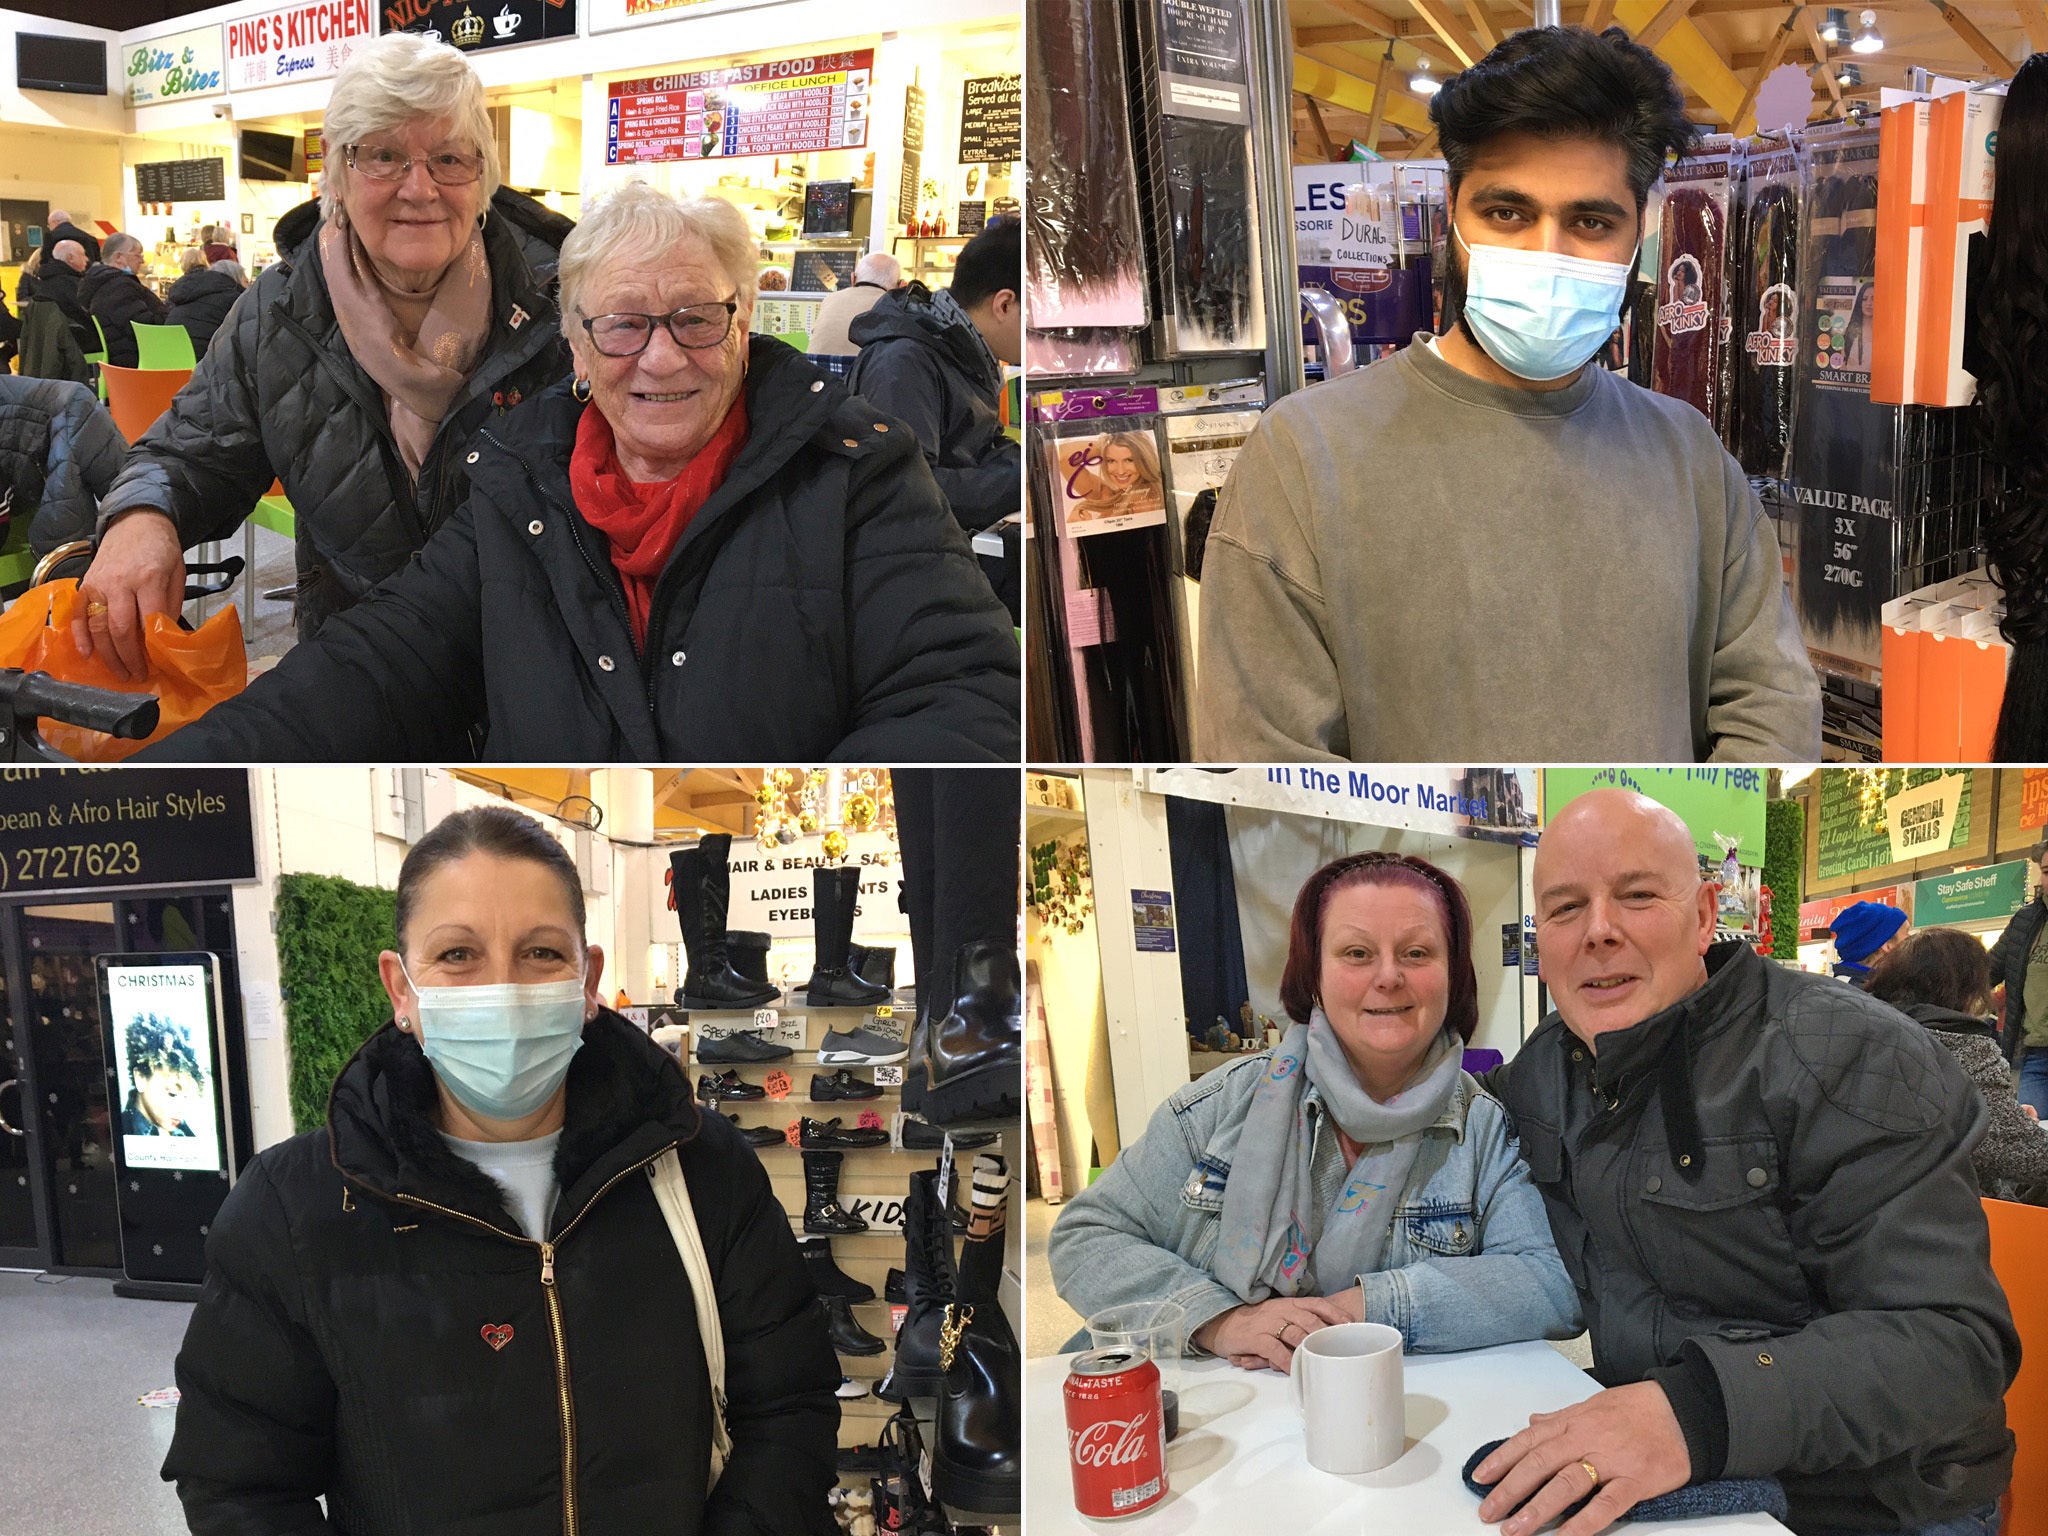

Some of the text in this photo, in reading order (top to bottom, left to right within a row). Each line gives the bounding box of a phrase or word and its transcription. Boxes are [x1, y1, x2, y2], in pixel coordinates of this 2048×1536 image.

[1162, 0, 1232, 19] DOUBLE WEFTED
[288, 0, 369, 48] KITCHEN
[127, 46, 194, 77] Bitz &
[276, 53, 315, 78] Express
[160, 67, 220, 96] Bitez
[653, 57, 815, 91] CHINESE FAST FOOD
[744, 75, 836, 93] OFFICE LUNCH
[636, 94, 667, 105] SPRING ROLL
[788, 90, 802, 98] WITH
[803, 86, 830, 97] NOODLES
[968, 93, 1009, 105] Served all
[611, 102, 617, 115] A
[642, 107, 654, 115] Eggs
[655, 105, 668, 113] Fried
[669, 104, 679, 112] Rice
[792, 99, 804, 108] WITH
[805, 96, 828, 107] NOODLES
[767, 112, 789, 121] CHICKEN
[790, 110, 803, 119] WITH
[804, 107, 828, 117] NOODLES
[965, 107, 983, 116] LARGE
[610, 124, 617, 137] B
[624, 120, 638, 129] SPRING
[653, 118, 670, 127] CHICKEN
[740, 125, 762, 134] CHICKEN
[766, 122, 787, 132] PEANUT
[787, 120, 801, 129] WITH
[802, 118, 827, 128] NOODLES
[964, 121, 987, 129] MEDIUM
[642, 129, 654, 138] Eggs
[655, 127, 667, 135] Fried
[668, 126, 679, 134] Rice
[750, 133, 784, 143] VEGETABLES
[785, 131, 799, 140] WITH
[800, 129, 826, 138] NOODLES
[649, 139, 670, 147] CHICKEN
[752, 143, 771, 152] FOOD
[772, 142, 790, 151] WITH
[792, 139, 826, 150] NOODLES
[609, 146, 616, 159] C
[963, 148, 987, 156] EXTRAS
[1664, 163, 1726, 178] SMART BRAID
[1295, 182, 1346, 211] ES
[1337, 249, 1388, 264] COLLECTIONS
[1335, 270, 1390, 283] RED
[1659, 305, 1683, 320] AFRO
[1672, 311, 1705, 331] KINKY
[1747, 334, 1770, 348] AFRO
[1759, 347, 1793, 362] KINKY
[1820, 370, 1854, 382] SMART
[1792, 486, 1893, 519] VALUE PACK
[1834, 517, 1856, 537] 3X
[1823, 564, 1863, 588] 270G
[1839, 738, 1869, 755] SMART
[1301, 768, 1340, 794] the
[1349, 771, 1410, 805] Moor
[1417, 783, 1488, 819] Market
[47, 804, 63, 828] &
[69, 798, 111, 825] Afro
[116, 795, 160, 821] Hair
[166, 789, 226, 822] Styles
[1900, 798, 1944, 828] GENERAL
[1902, 820, 1940, 848] STALLS
[17, 840, 141, 880] 2727623
[764, 859, 776, 871] &
[782, 854, 850, 870] BEAUTY
[1818, 861, 1847, 879] Greeting
[1847, 853, 1869, 871] Cards
[1937, 872, 1997, 897] Stay Safe Sheff
[751, 886, 808, 901] LADIES
[117, 974, 195, 987] CHRISTMAS
[1240, 1038, 1262, 1050] JOY
[1087, 1376, 1123, 1388] TASTE
